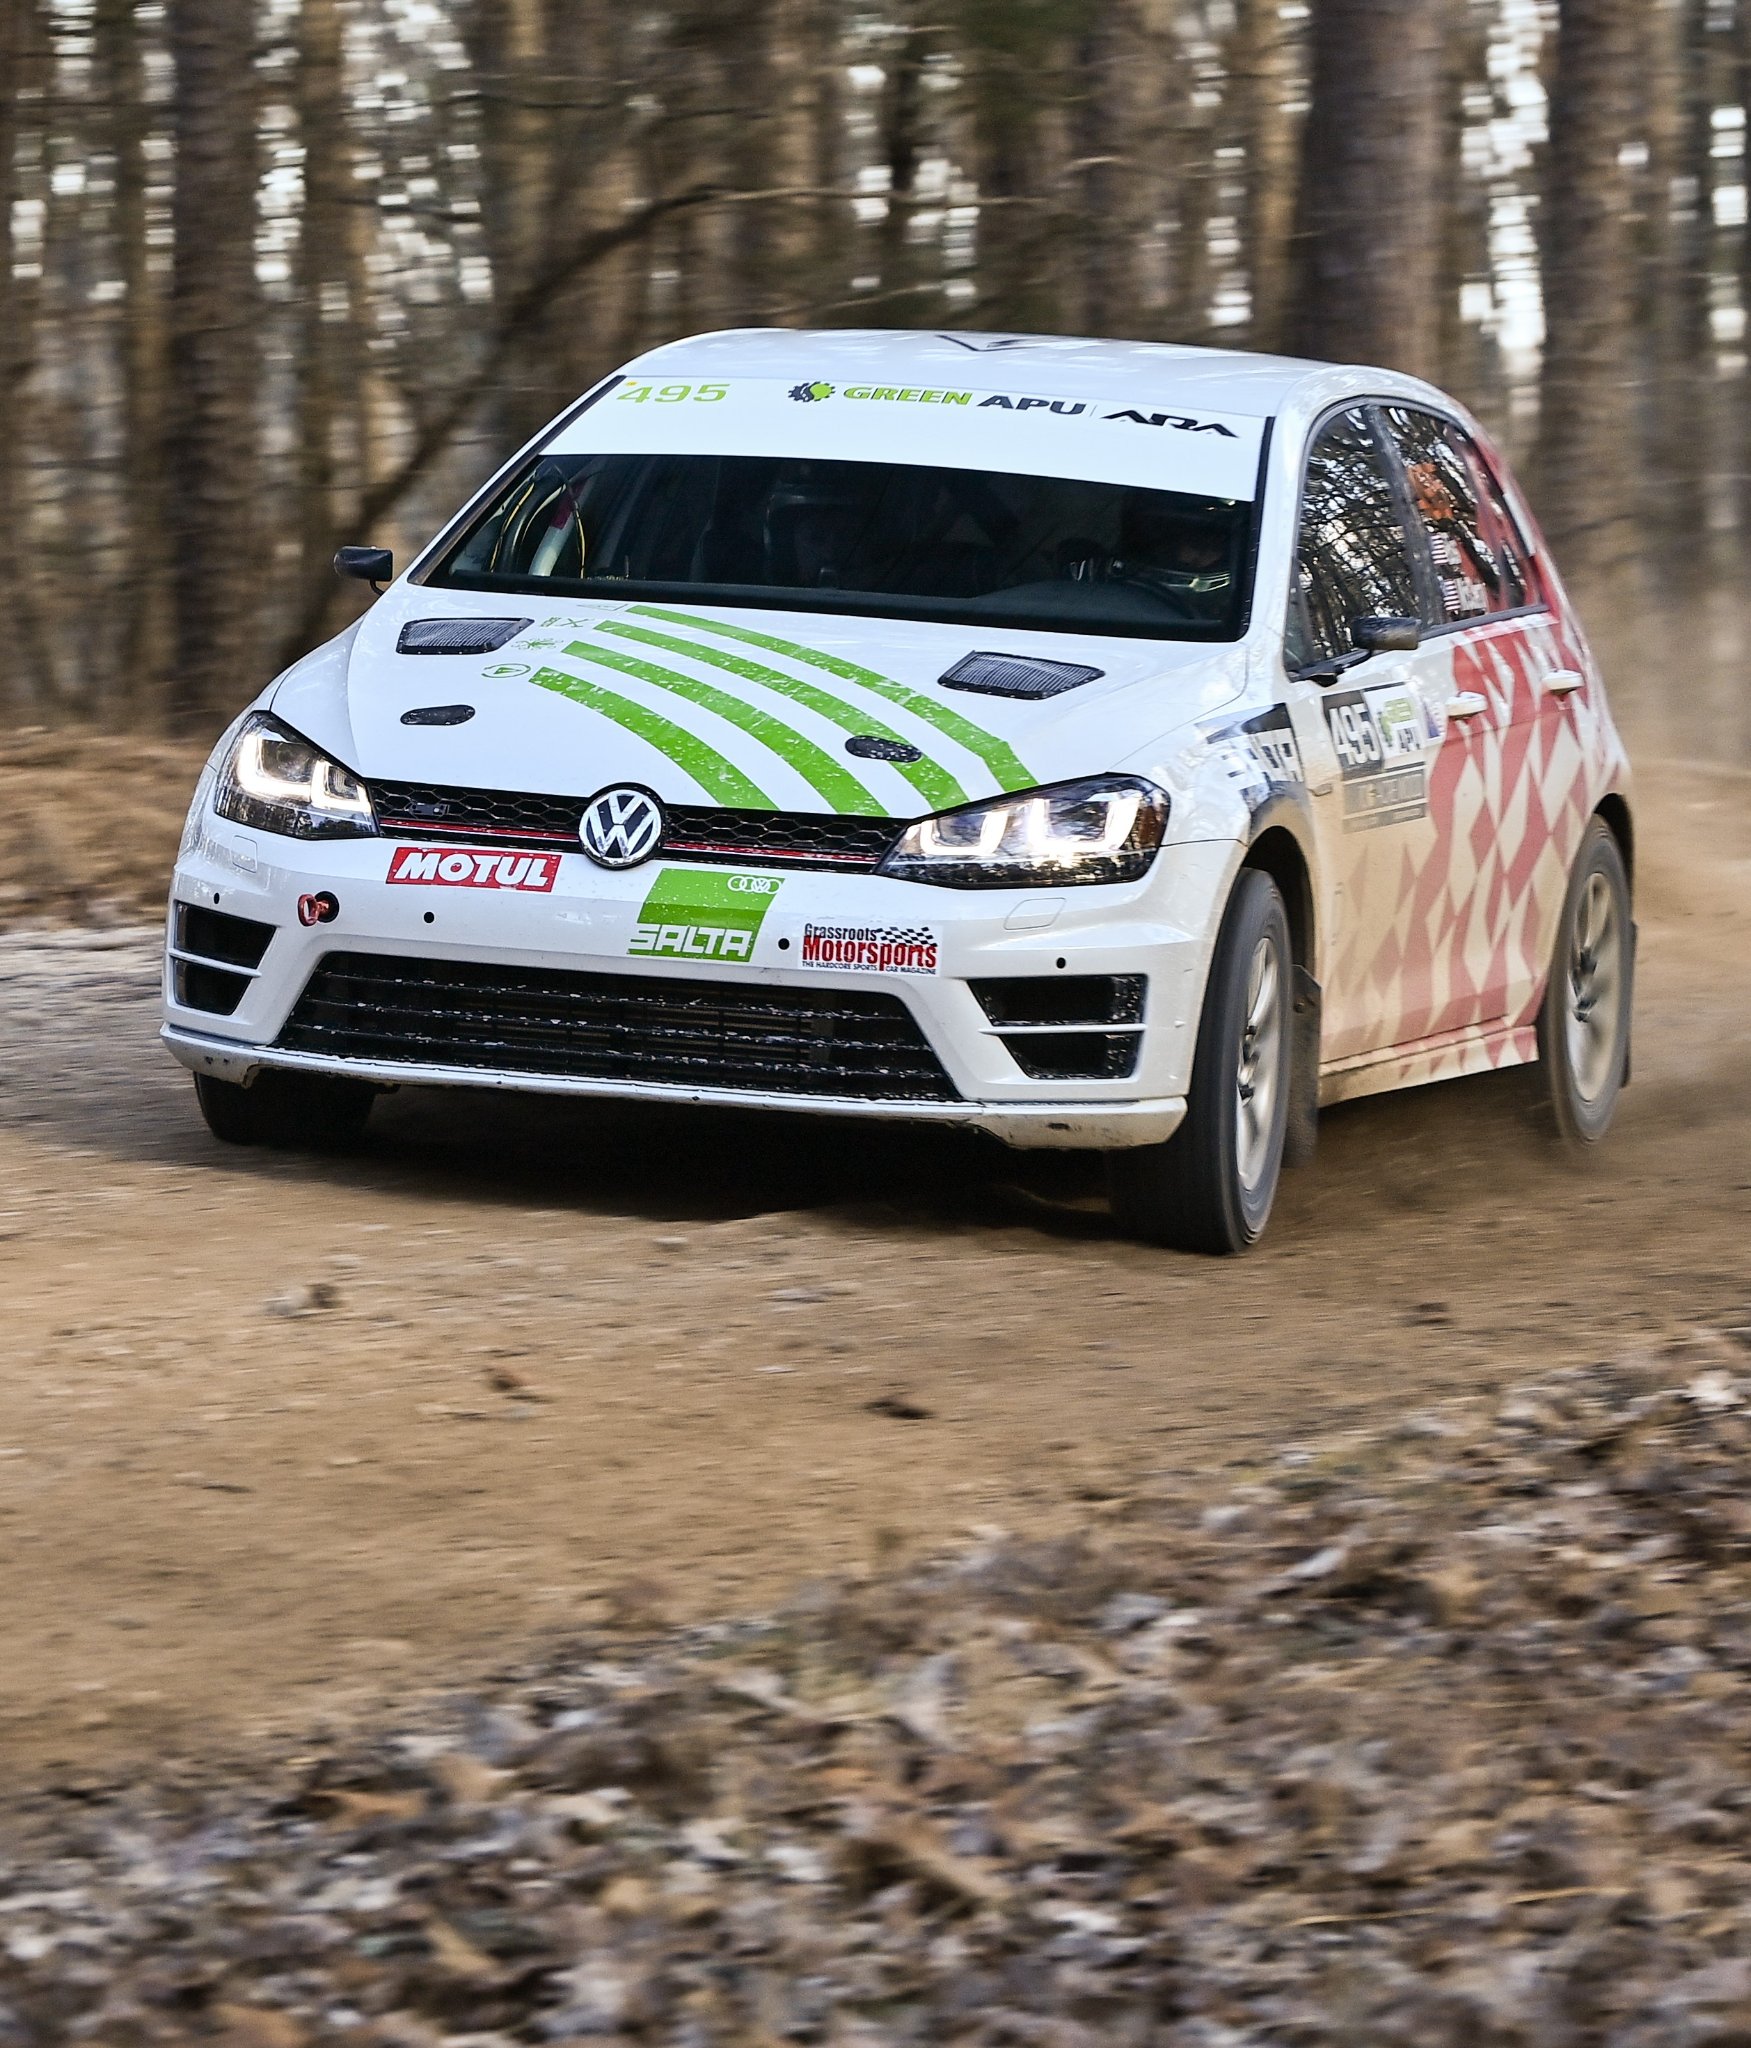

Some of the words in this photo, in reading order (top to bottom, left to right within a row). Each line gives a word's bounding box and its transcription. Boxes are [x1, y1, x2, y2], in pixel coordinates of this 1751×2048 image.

[616, 384, 731, 404] 495
[843, 387, 973, 406] GREEN
[976, 395, 1087, 415] APU
[1100, 410, 1240, 438] ARA
[1329, 703, 1381, 766] 495
[393, 852, 551, 887] MOTUL
[627, 923, 753, 958] SALTA
[804, 923, 877, 942] Grassroots
[802, 935, 937, 972] Motorsports
[801, 960, 814, 968] THE
[816, 961, 851, 970] HARDCORE
[886, 965, 898, 973] CAR
[900, 967, 937, 976] MAGAZINE
